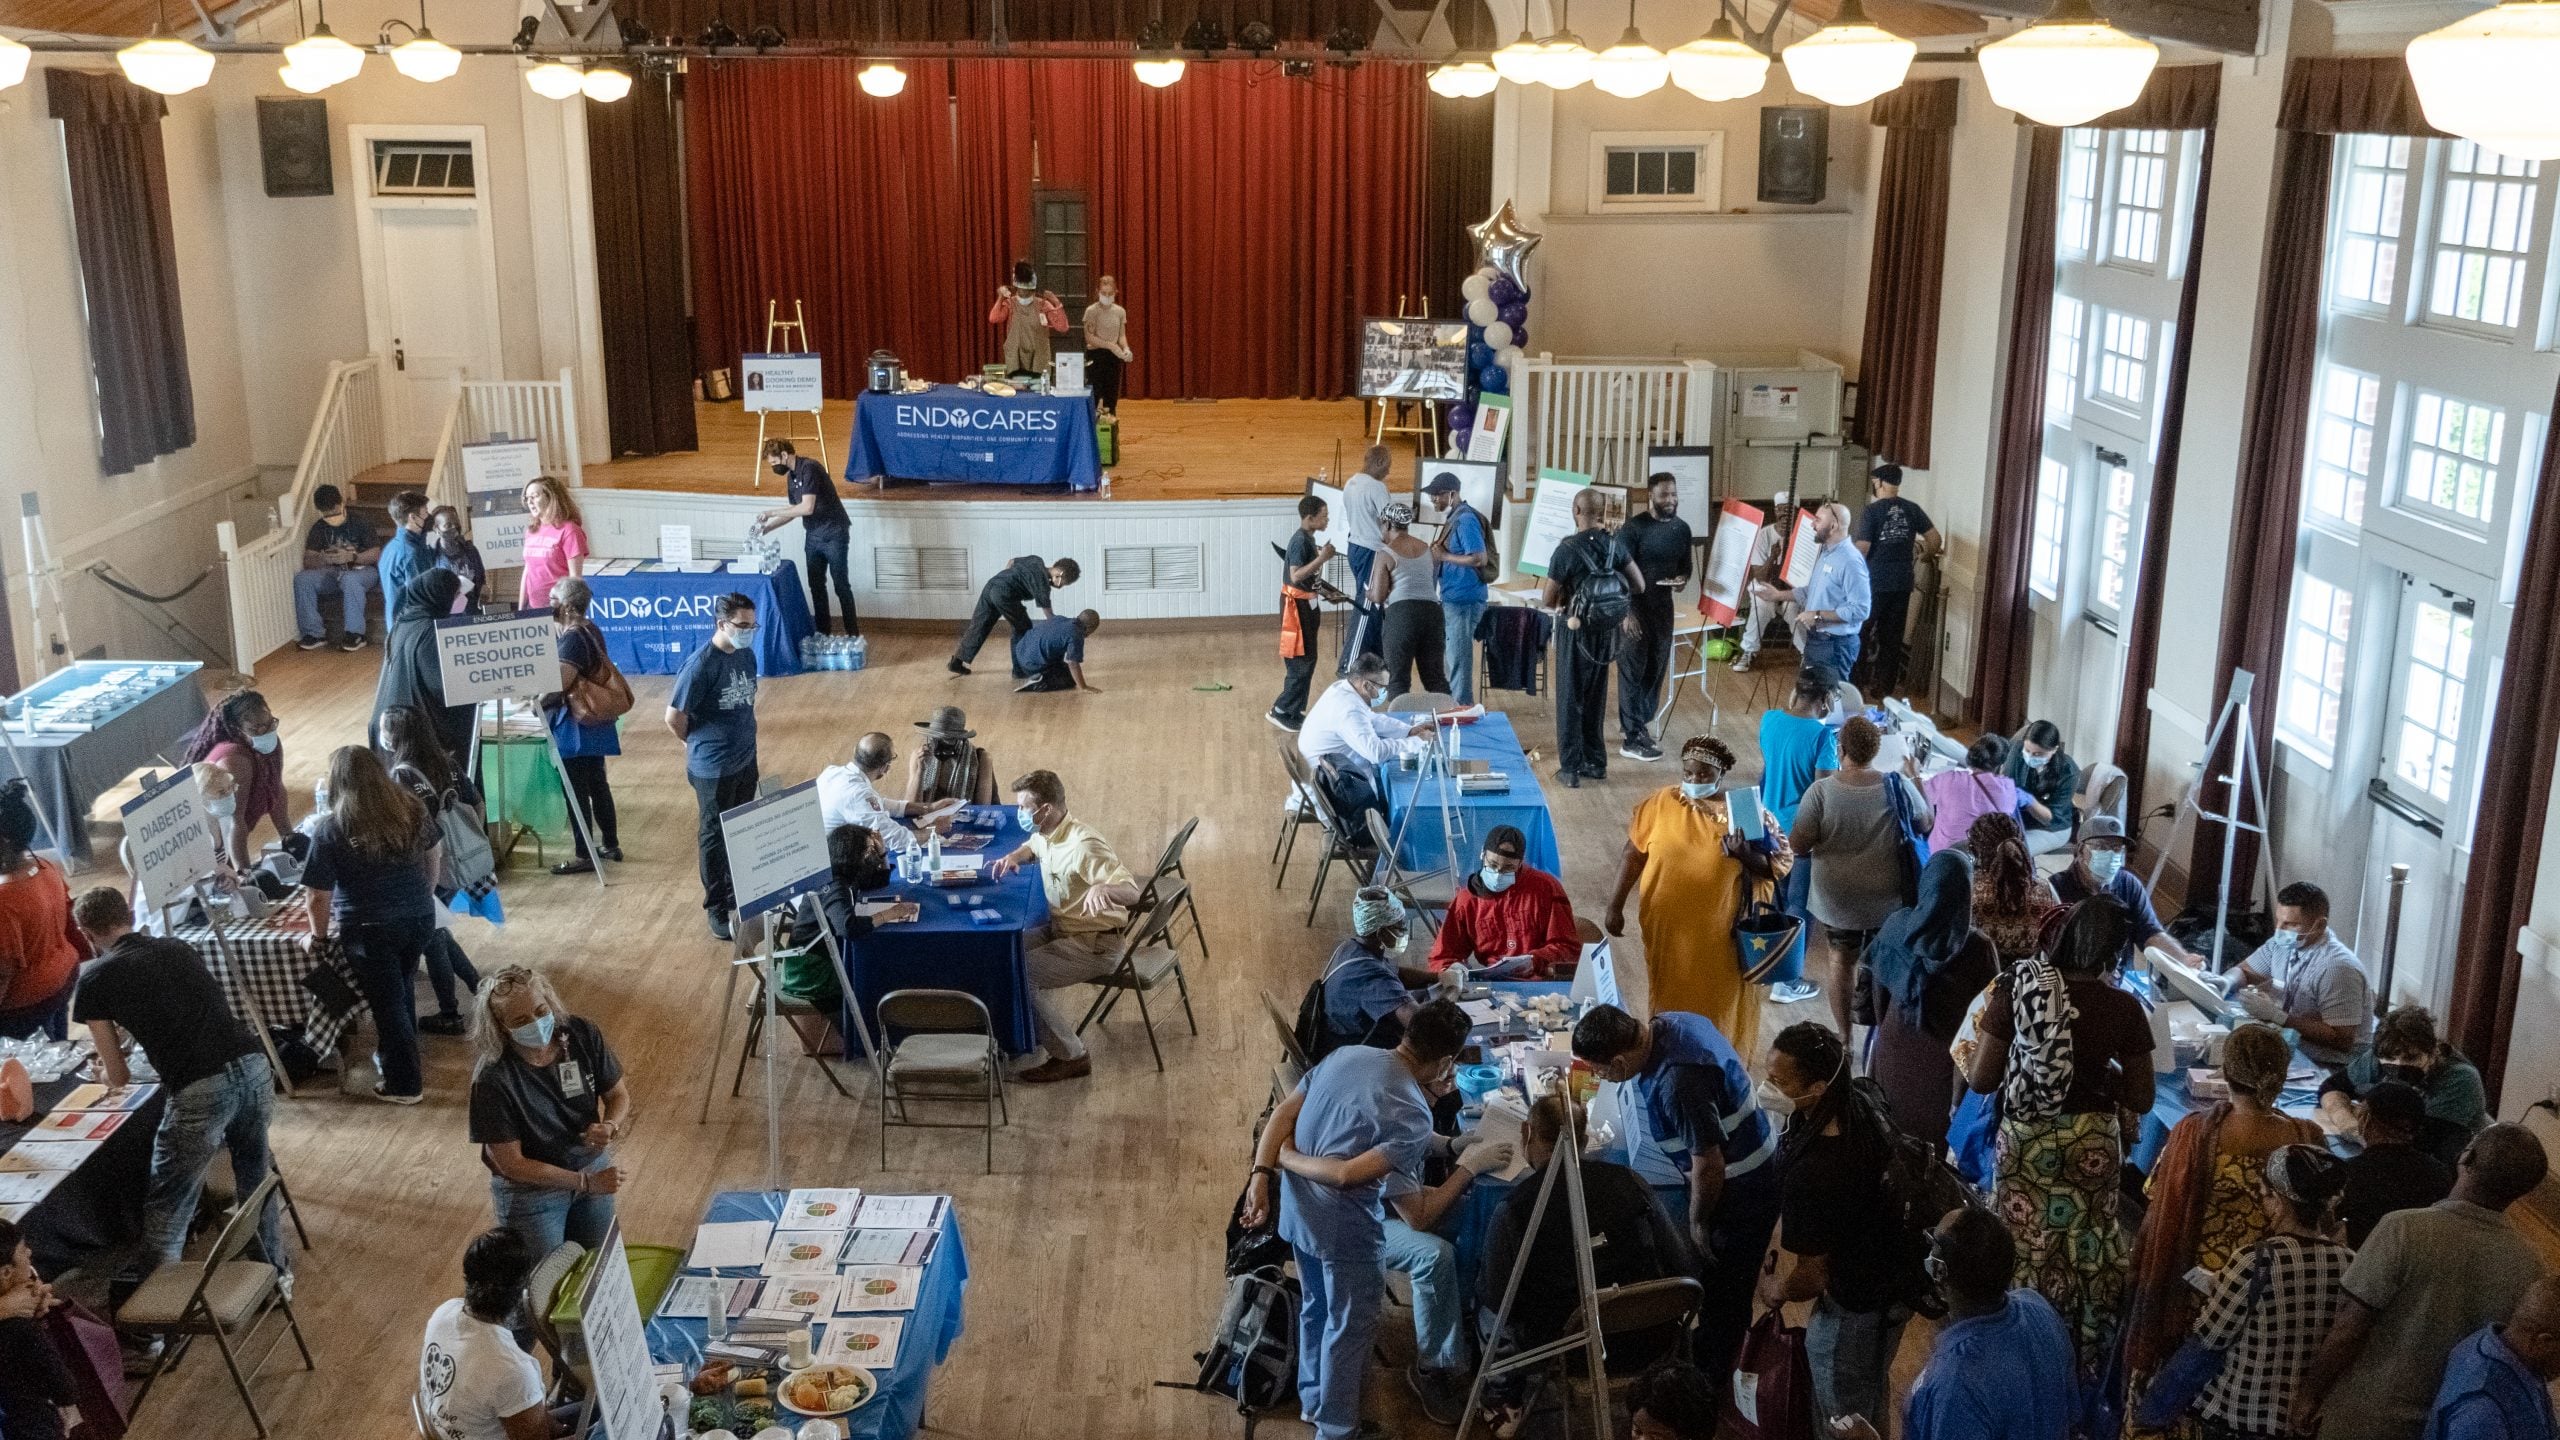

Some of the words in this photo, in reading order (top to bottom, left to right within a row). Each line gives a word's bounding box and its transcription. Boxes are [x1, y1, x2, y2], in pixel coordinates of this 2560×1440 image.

[498, 525, 525, 536] LILLY
[486, 538, 525, 550] DIABET
[444, 624, 549, 648] PREVENTION
[454, 644, 545, 666] RESOURCE
[469, 664, 535, 684] CENTER
[140, 800, 191, 843] DIABETES
[142, 821, 202, 872] EDUCATION
